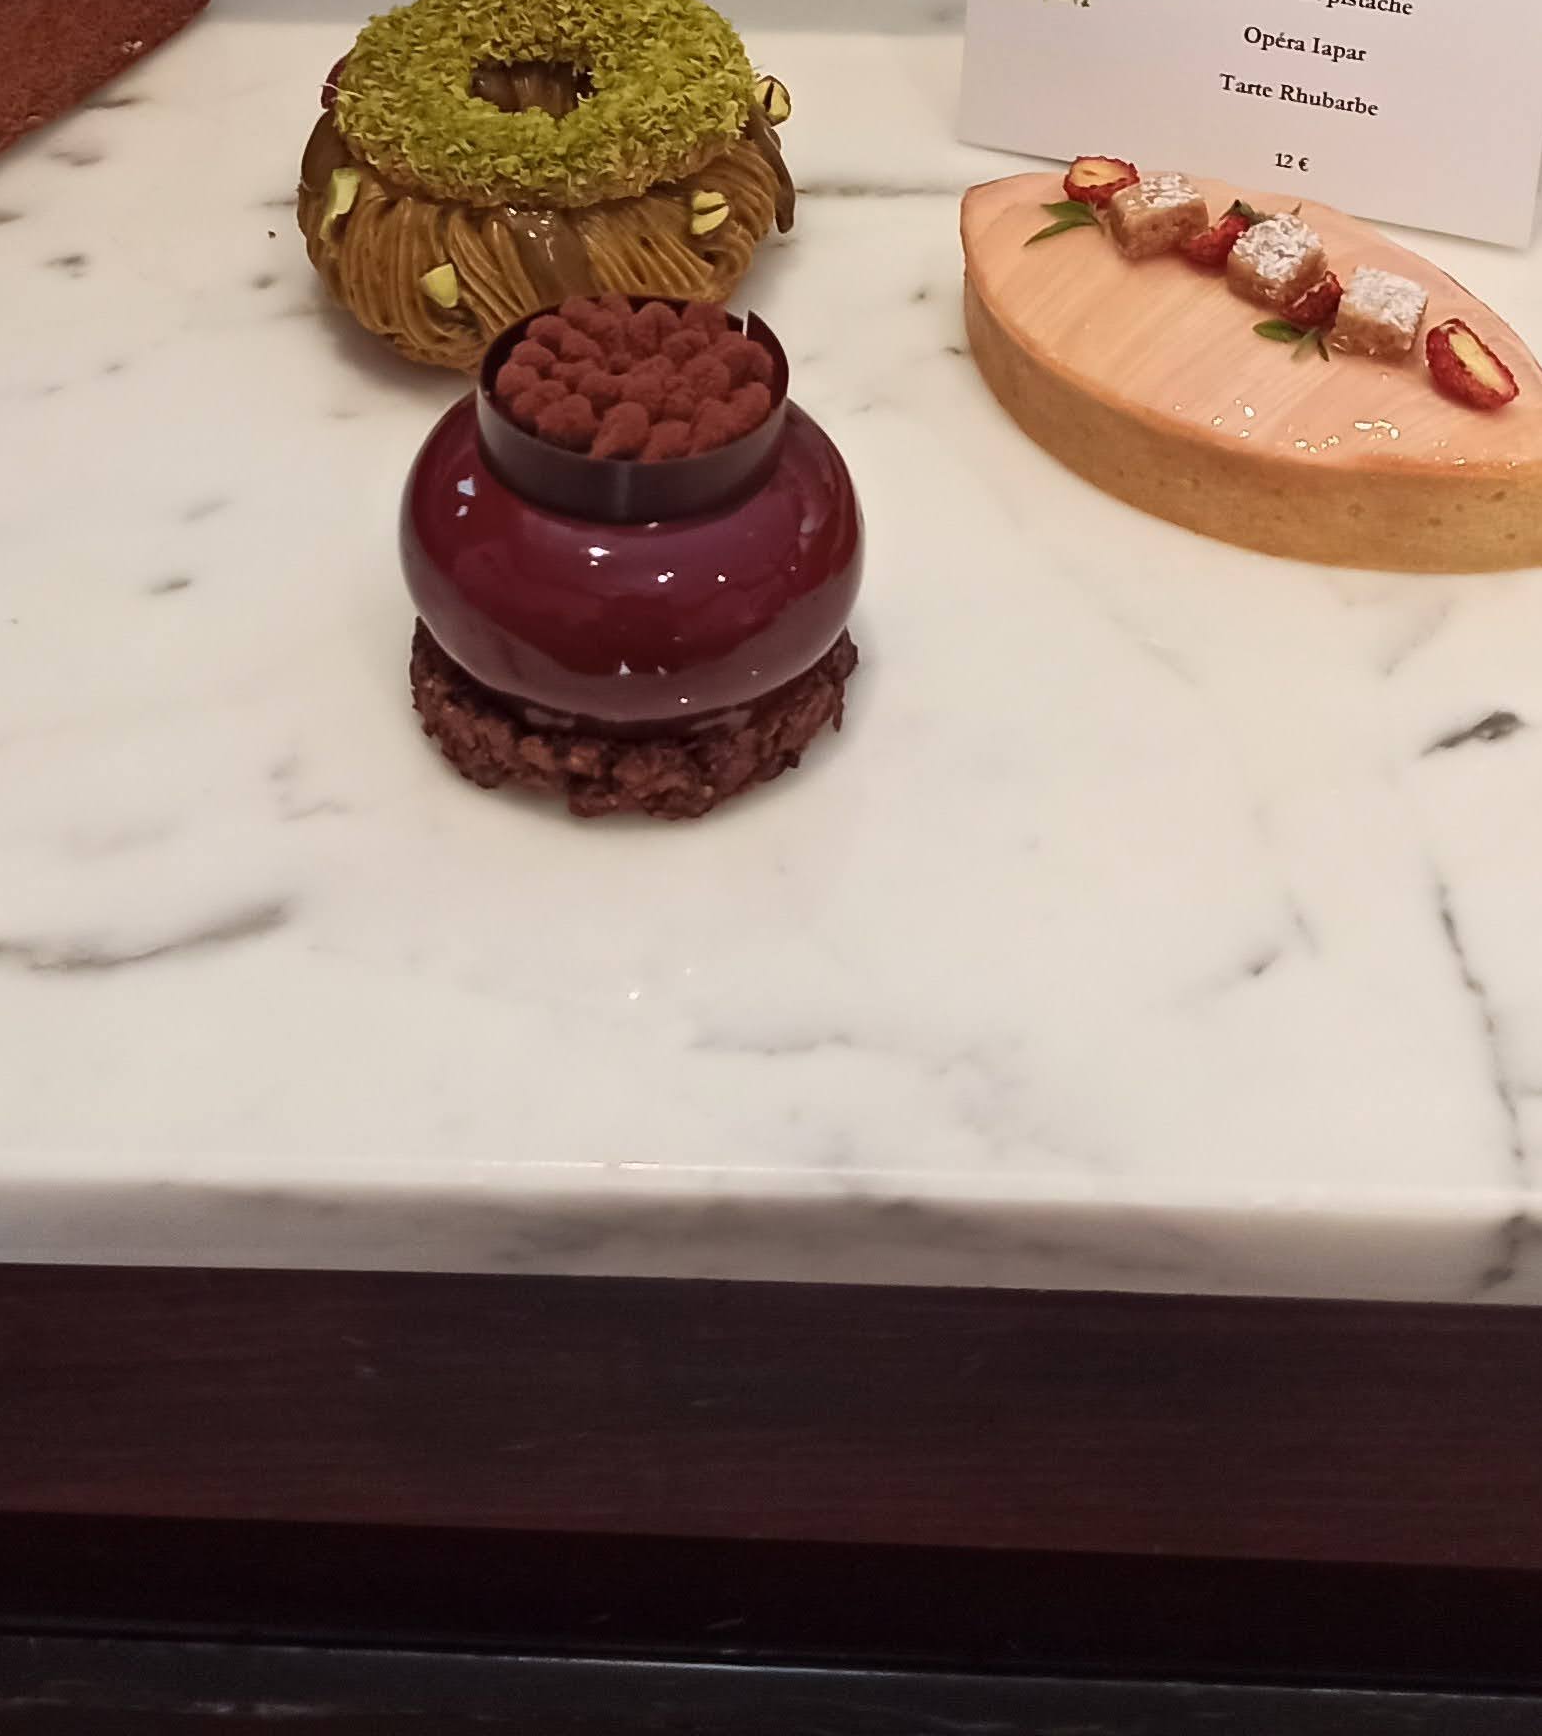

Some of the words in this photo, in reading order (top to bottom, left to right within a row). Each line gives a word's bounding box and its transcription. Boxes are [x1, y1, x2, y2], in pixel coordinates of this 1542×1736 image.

[1243, 26, 1305, 52] Opéra
[1219, 73, 1273, 98] Tarte
[1279, 84, 1380, 117] Rhubarbe
[1275, 152, 1294, 168] 12
[1298, 156, 1310, 172] €
